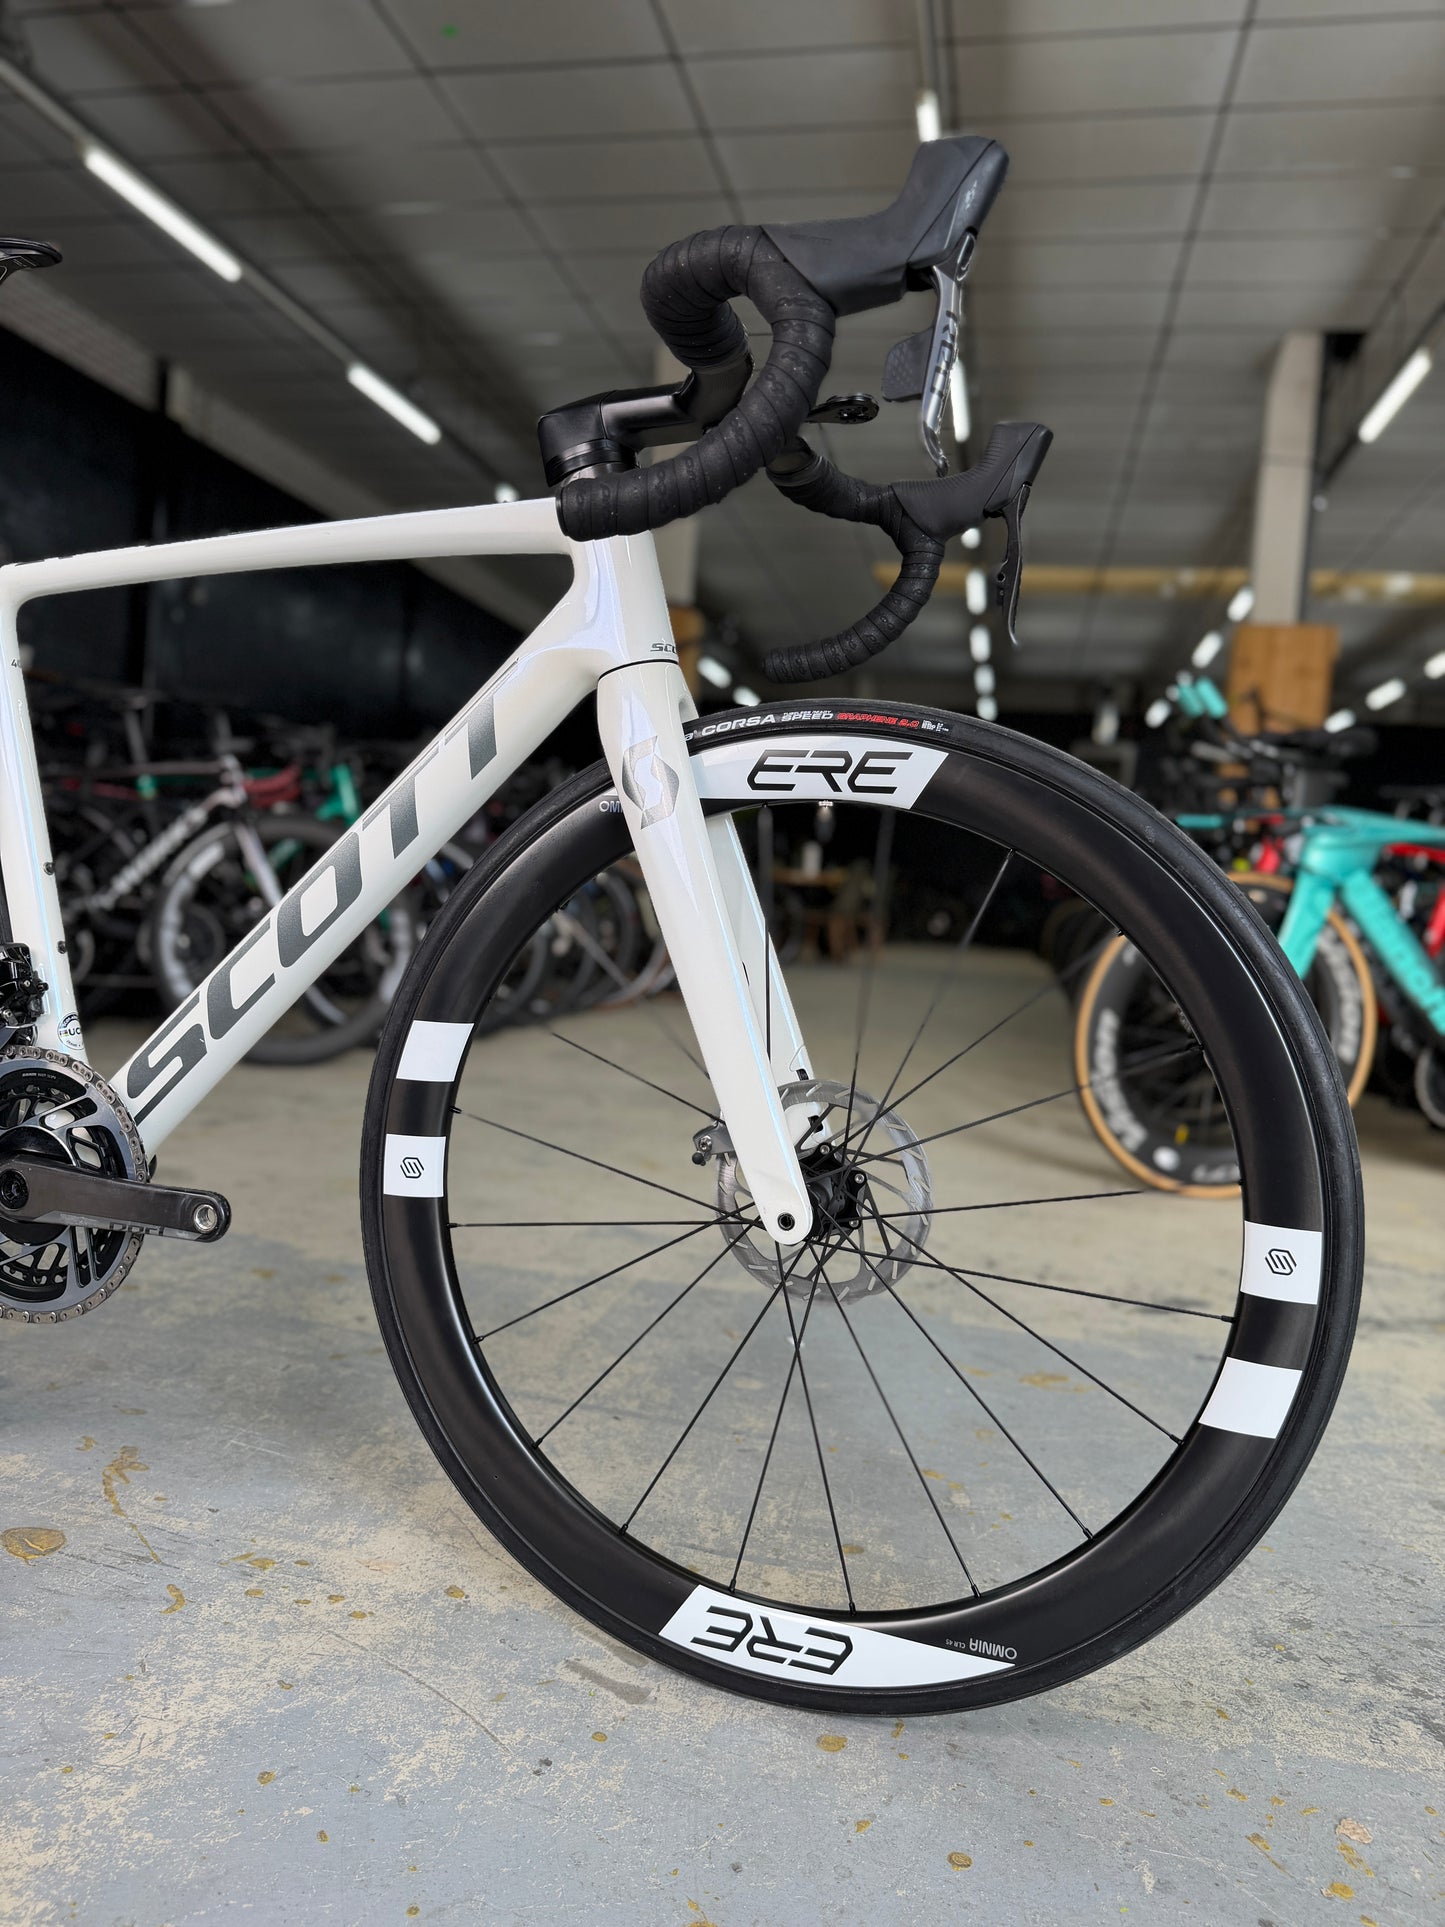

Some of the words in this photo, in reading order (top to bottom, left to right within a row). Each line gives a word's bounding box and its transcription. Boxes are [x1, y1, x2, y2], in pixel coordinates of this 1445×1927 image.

[702, 714, 776, 736] CORSA
[782, 712, 834, 722] SPEED
[747, 749, 914, 795] ERE
[127, 660, 518, 1127] SCOTT
[690, 1605, 854, 1676] ERE
[969, 1638, 1018, 1660] OMNIA
